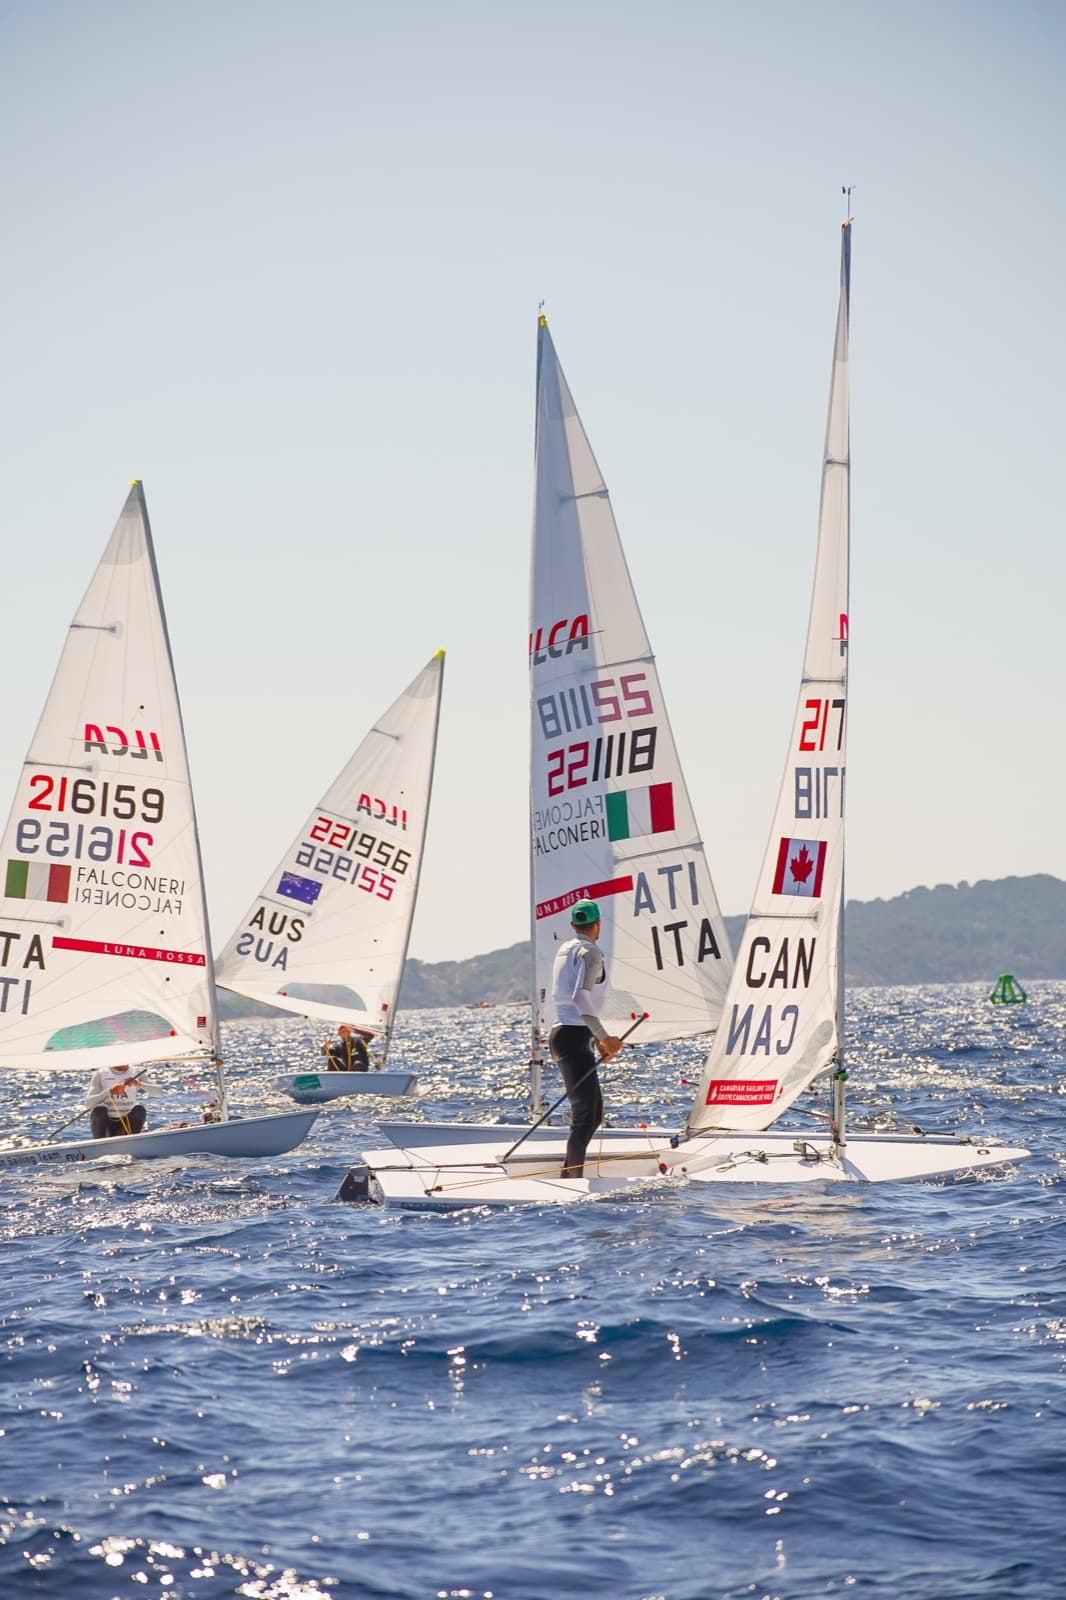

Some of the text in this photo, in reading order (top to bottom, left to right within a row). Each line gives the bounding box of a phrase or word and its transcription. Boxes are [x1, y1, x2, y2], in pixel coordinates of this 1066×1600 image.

[529, 614, 588, 671] ILCA
[799, 699, 845, 751] 217
[547, 726, 657, 797] 221118
[28, 774, 164, 824] 216159
[310, 816, 412, 875] 221956
[77, 867, 185, 896] FALCONERI
[248, 906, 305, 943] AUS
[535, 904, 560, 918] UNA
[0, 931, 46, 970] TA
[103, 943, 206, 965] LUNA ROSSA
[651, 918, 722, 971] ITA
[745, 936, 816, 989] CAN
